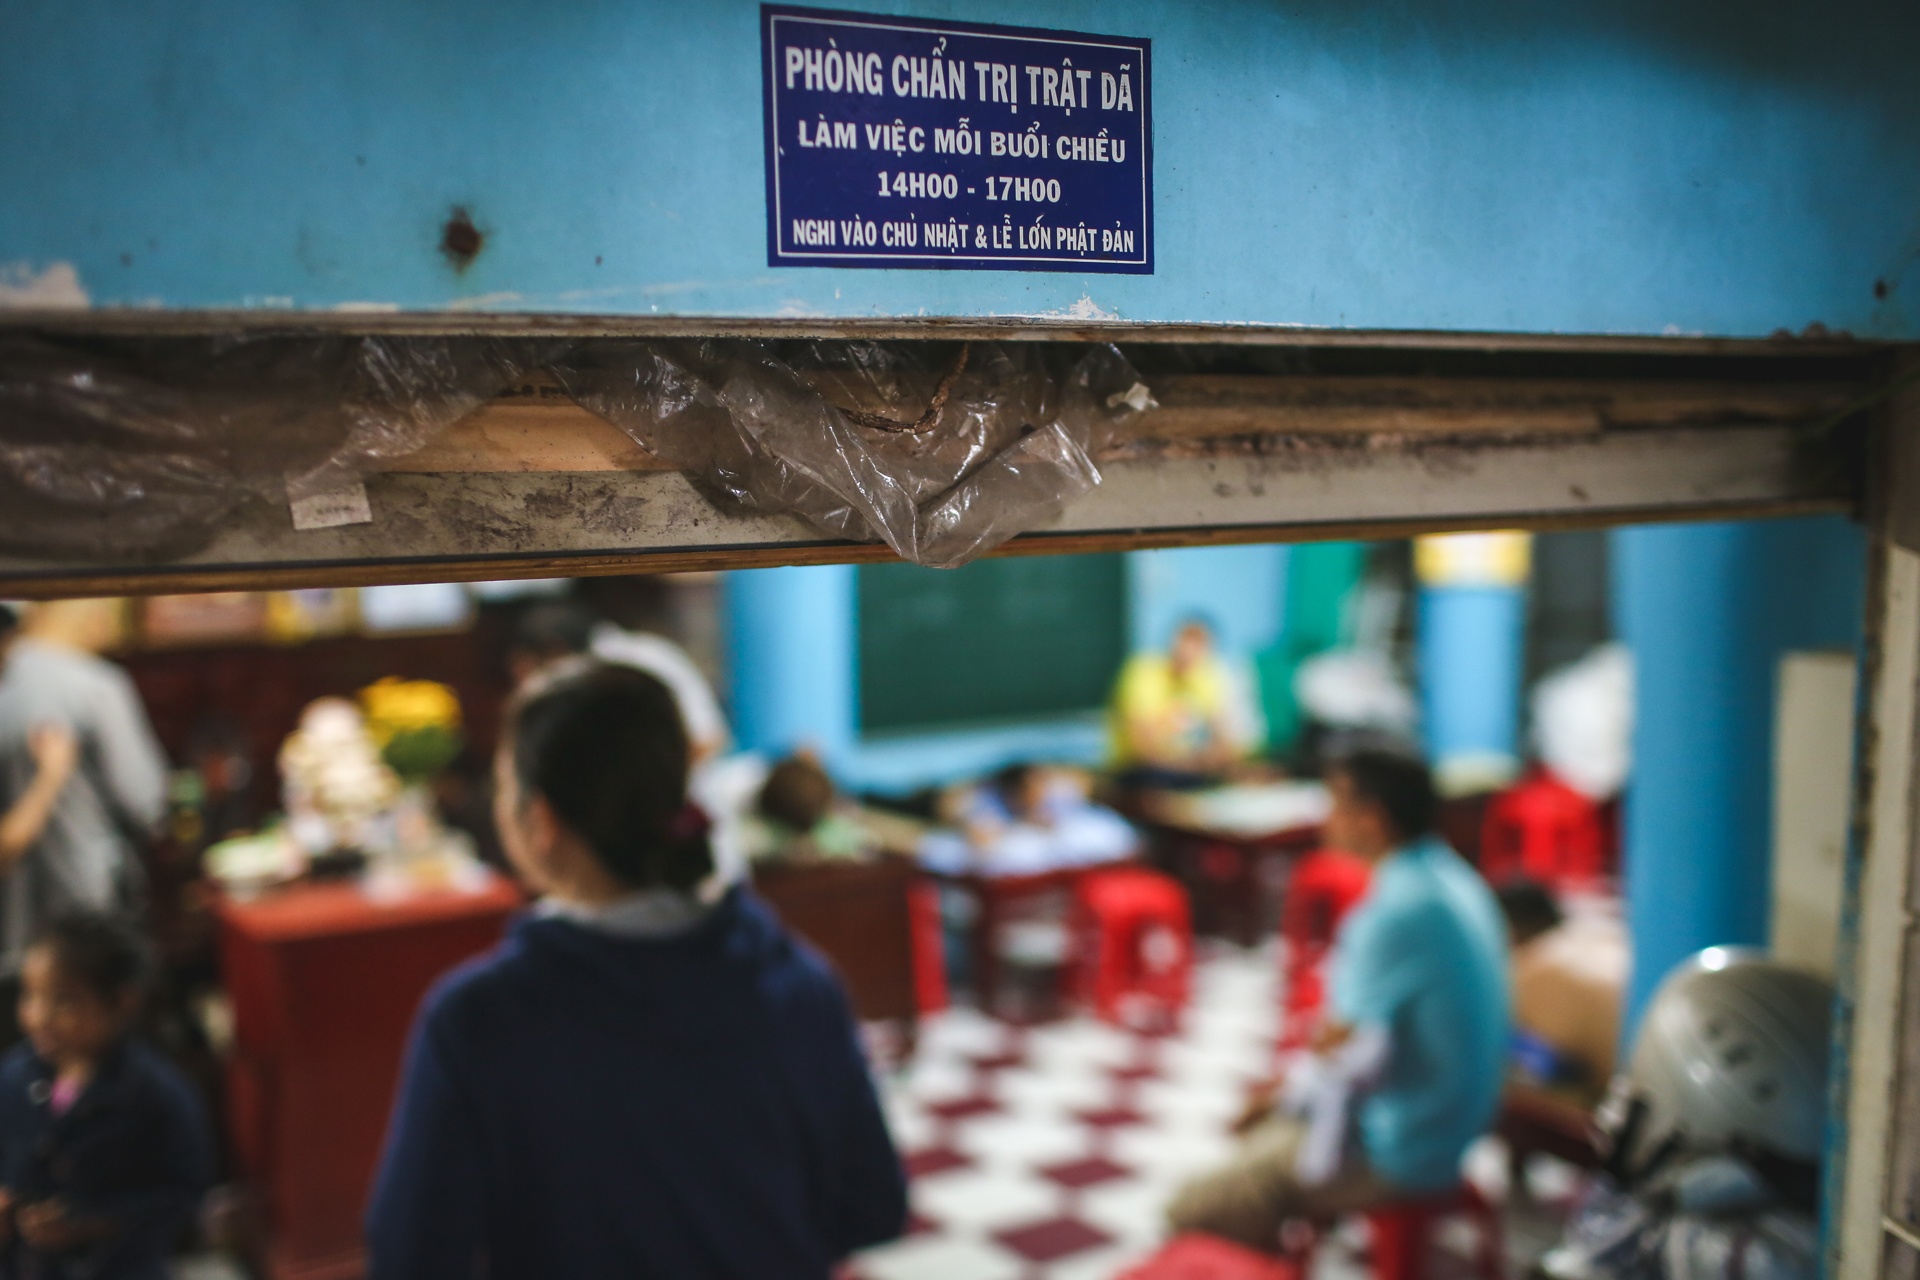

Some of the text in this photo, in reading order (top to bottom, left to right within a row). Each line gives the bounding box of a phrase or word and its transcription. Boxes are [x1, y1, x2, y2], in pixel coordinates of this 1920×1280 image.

[785, 37, 1134, 116] PHÒNG CHẨN TRỊ TRẬT DÃ
[798, 113, 1126, 163] LÀM VIỆC MỖI BUỔI CHIỀU
[840, 213, 877, 246] VÀO
[924, 216, 970, 253] NHẬT
[974, 224, 988, 249] &
[992, 213, 1013, 249] LỄ
[1018, 213, 1051, 250] LỚN
[1056, 221, 1098, 257] PHẬT
[1102, 220, 1134, 253] ĐẢN
